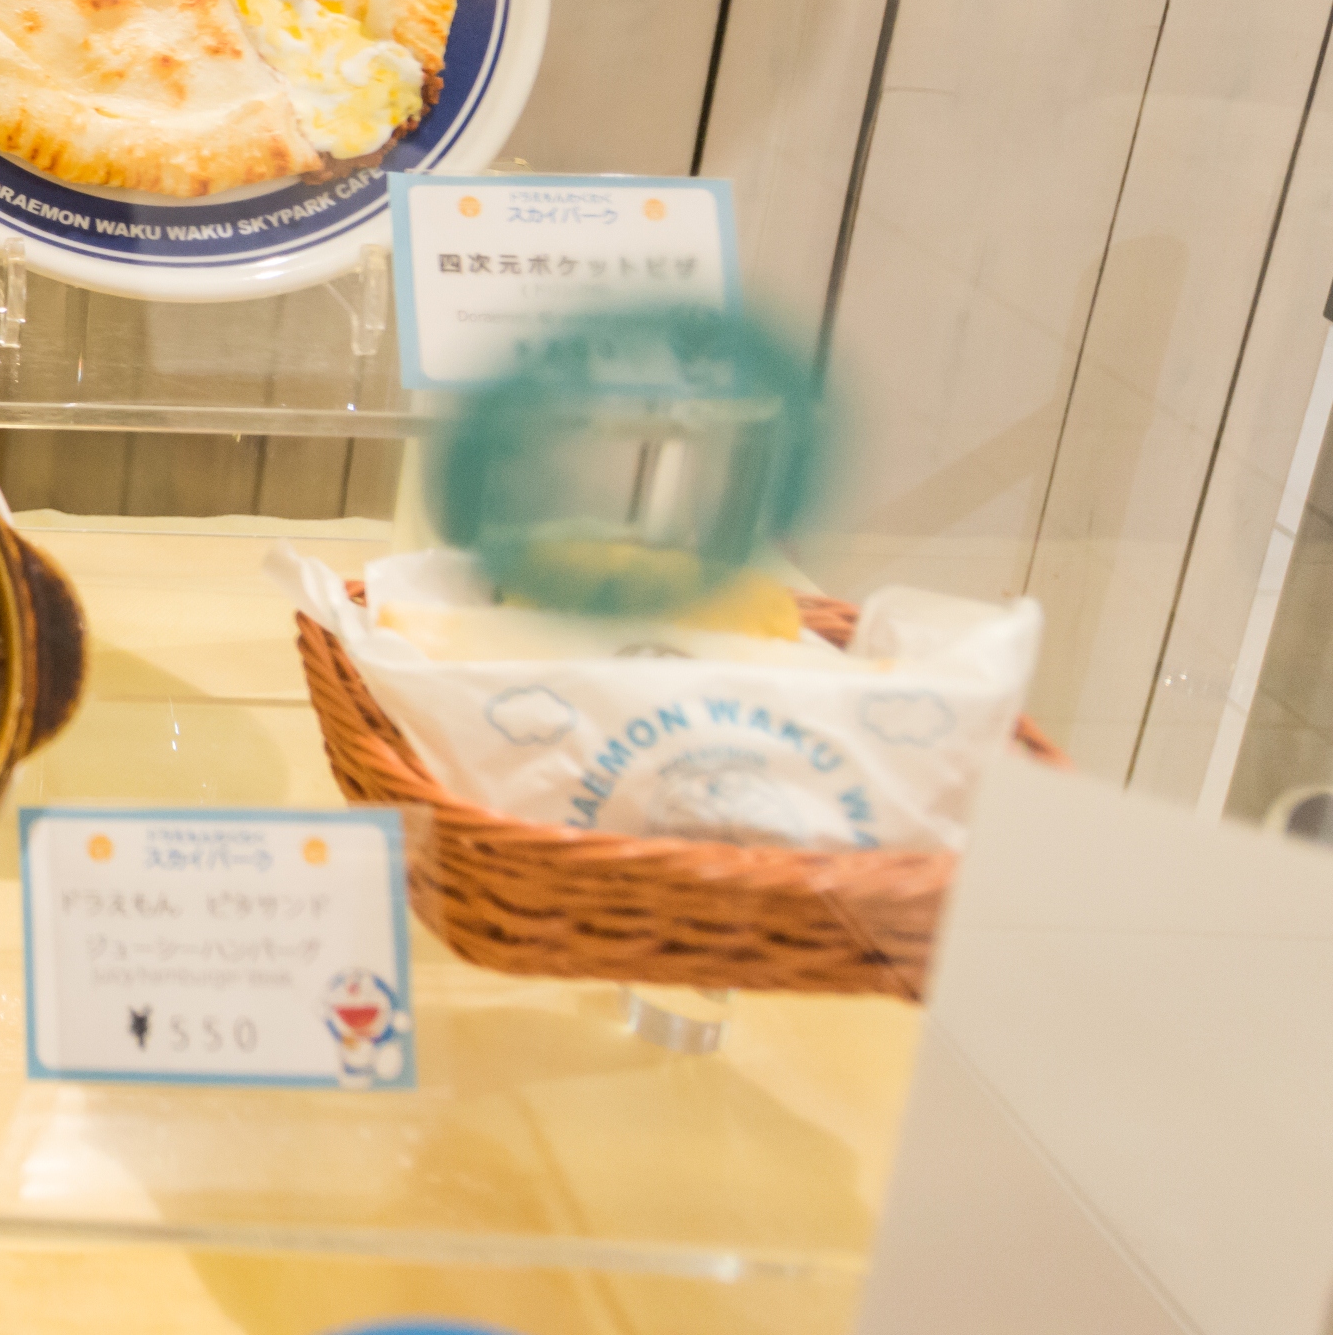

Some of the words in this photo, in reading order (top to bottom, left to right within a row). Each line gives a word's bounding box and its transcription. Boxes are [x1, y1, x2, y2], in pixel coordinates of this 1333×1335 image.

[95, 218, 162, 242] WAKU
[166, 221, 234, 242] WAKU
[237, 194, 336, 235] SKYPARK
